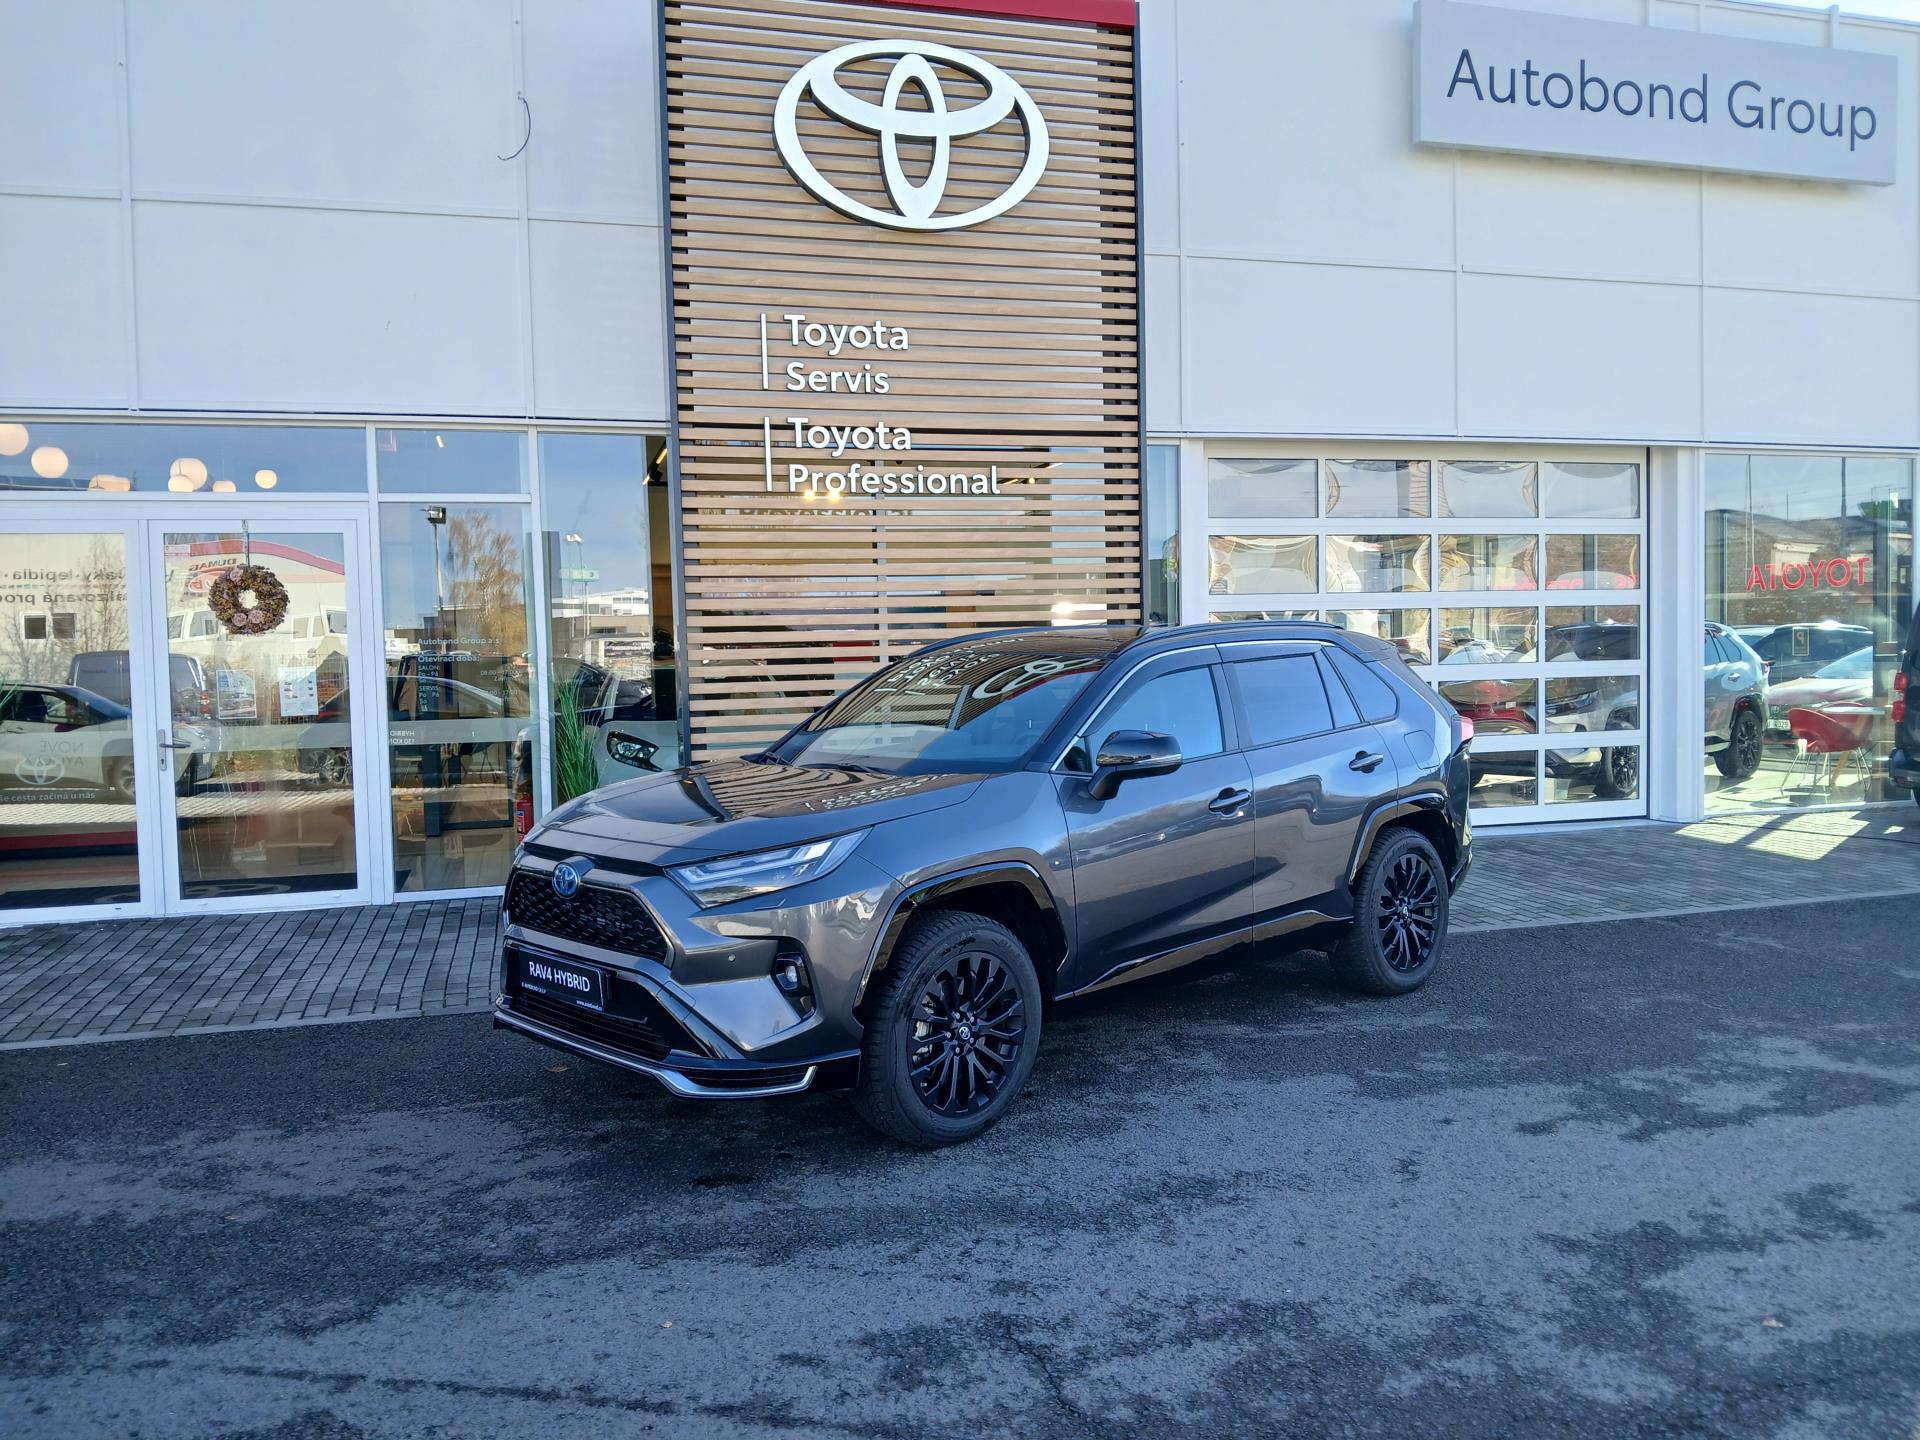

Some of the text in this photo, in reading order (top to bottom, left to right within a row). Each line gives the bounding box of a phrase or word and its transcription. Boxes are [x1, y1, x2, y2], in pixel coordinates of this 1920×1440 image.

[1445, 47, 1877, 151] Autobond Group
[783, 313, 910, 357] Toyota
[785, 361, 890, 394] Servis
[786, 416, 912, 457] Toyota
[788, 463, 1001, 496] Professional
[460, 637, 486, 646] Group
[11, 794, 36, 802] cesta
[70, 792, 77, 800] u
[528, 961, 553, 982] RAV4
[553, 968, 591, 992] HYBRID
